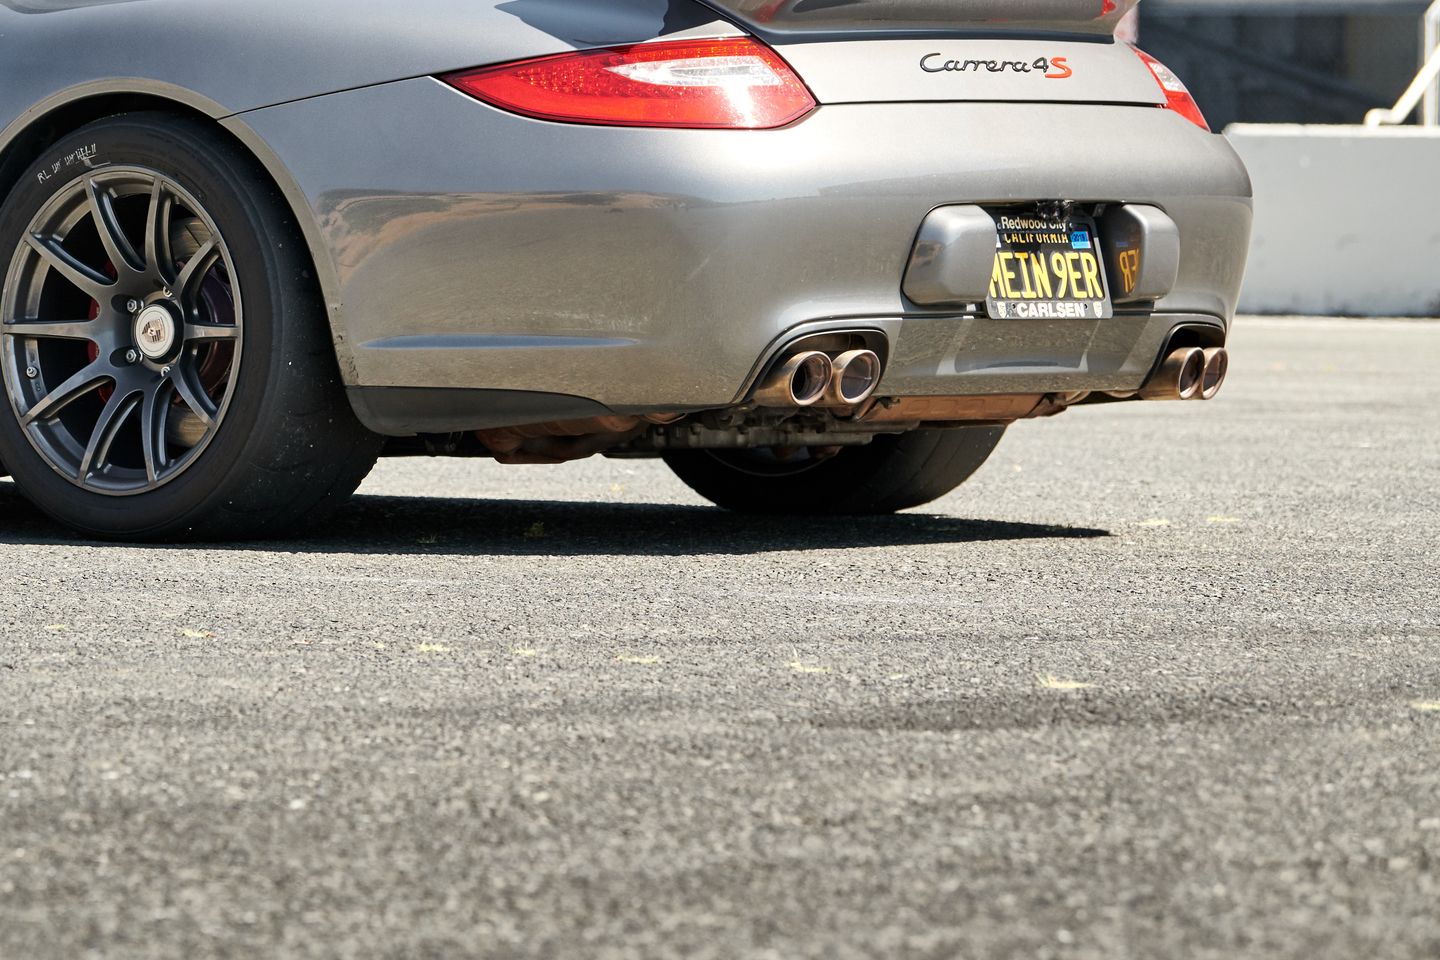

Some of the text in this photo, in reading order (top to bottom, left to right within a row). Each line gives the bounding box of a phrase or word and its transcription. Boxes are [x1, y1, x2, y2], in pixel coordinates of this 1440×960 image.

[919, 52, 1073, 79] Carrera 4S
[1001, 216, 1047, 230] Redwood
[989, 252, 1103, 299] MEIN 9ER
[1016, 302, 1086, 318] CARLSEN
